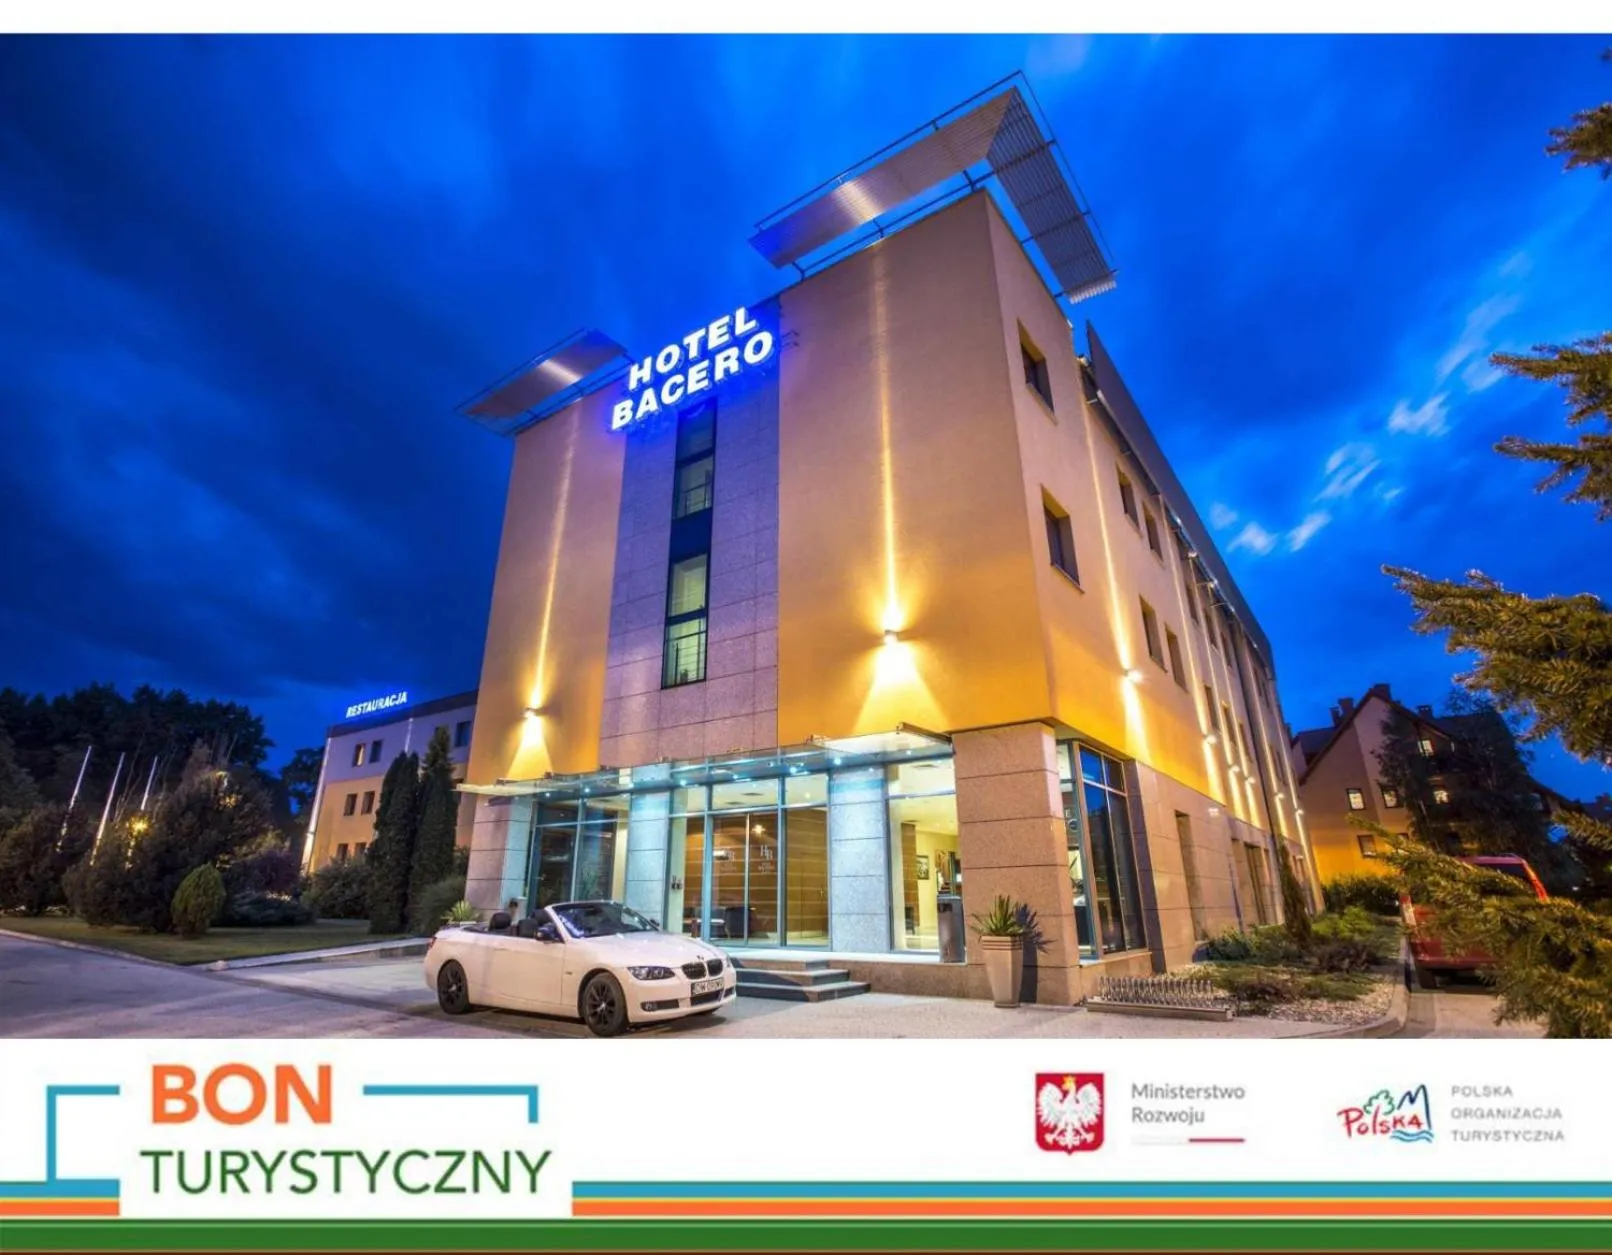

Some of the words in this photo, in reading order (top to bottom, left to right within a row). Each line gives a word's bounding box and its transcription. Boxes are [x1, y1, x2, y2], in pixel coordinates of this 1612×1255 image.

[611, 330, 773, 430] BACERO
[628, 307, 757, 391] HOTEL
[346, 691, 408, 718] RESTAURACJA
